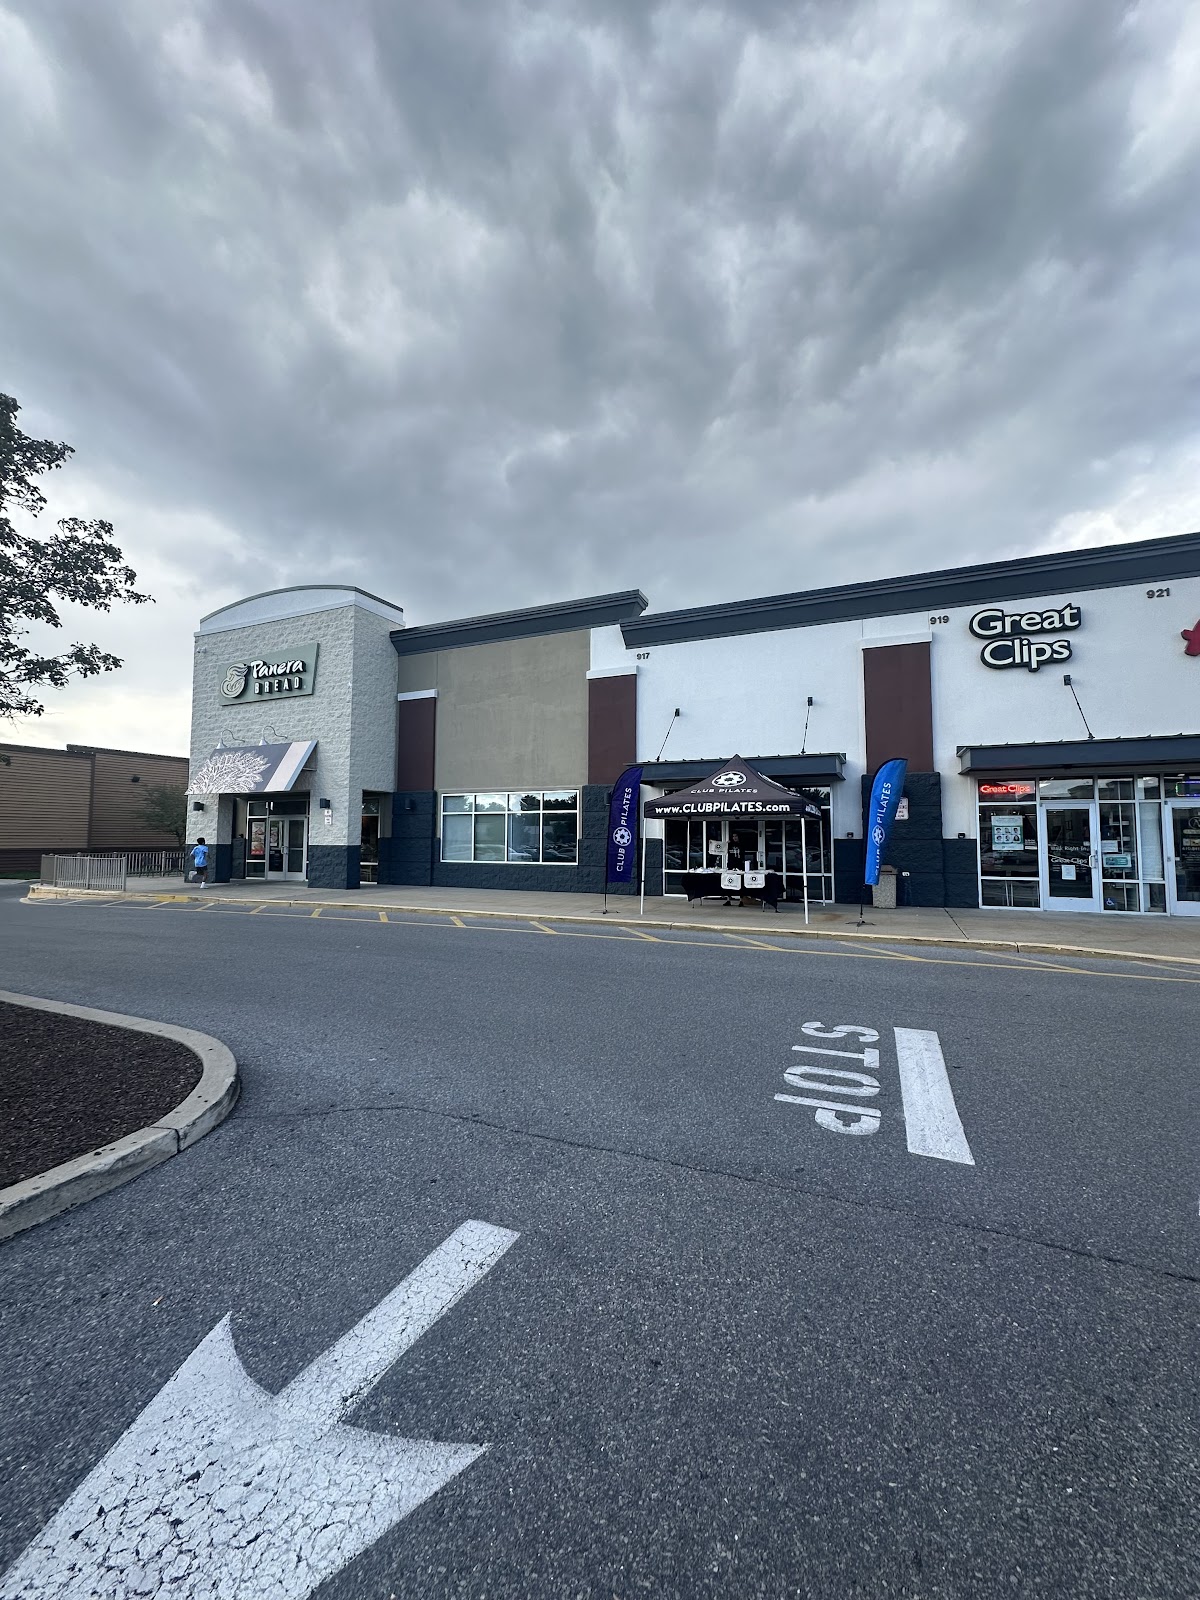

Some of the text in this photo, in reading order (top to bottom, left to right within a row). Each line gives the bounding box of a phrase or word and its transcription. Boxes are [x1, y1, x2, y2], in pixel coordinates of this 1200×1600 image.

[1146, 587, 1170, 599] 921
[929, 615, 949, 625] 919
[972, 606, 1079, 635] Great
[983, 639, 1071, 669] Clips
[250, 660, 304, 679] Panera
[254, 677, 301, 694] BREAD
[980, 785, 1031, 794] Great Clips
[655, 801, 791, 814] www.CLUBPILATES.com
[876, 782, 892, 823] PILATES
[616, 787, 632, 872] CLUB PILATES
[774, 1021, 882, 1136] STOP
